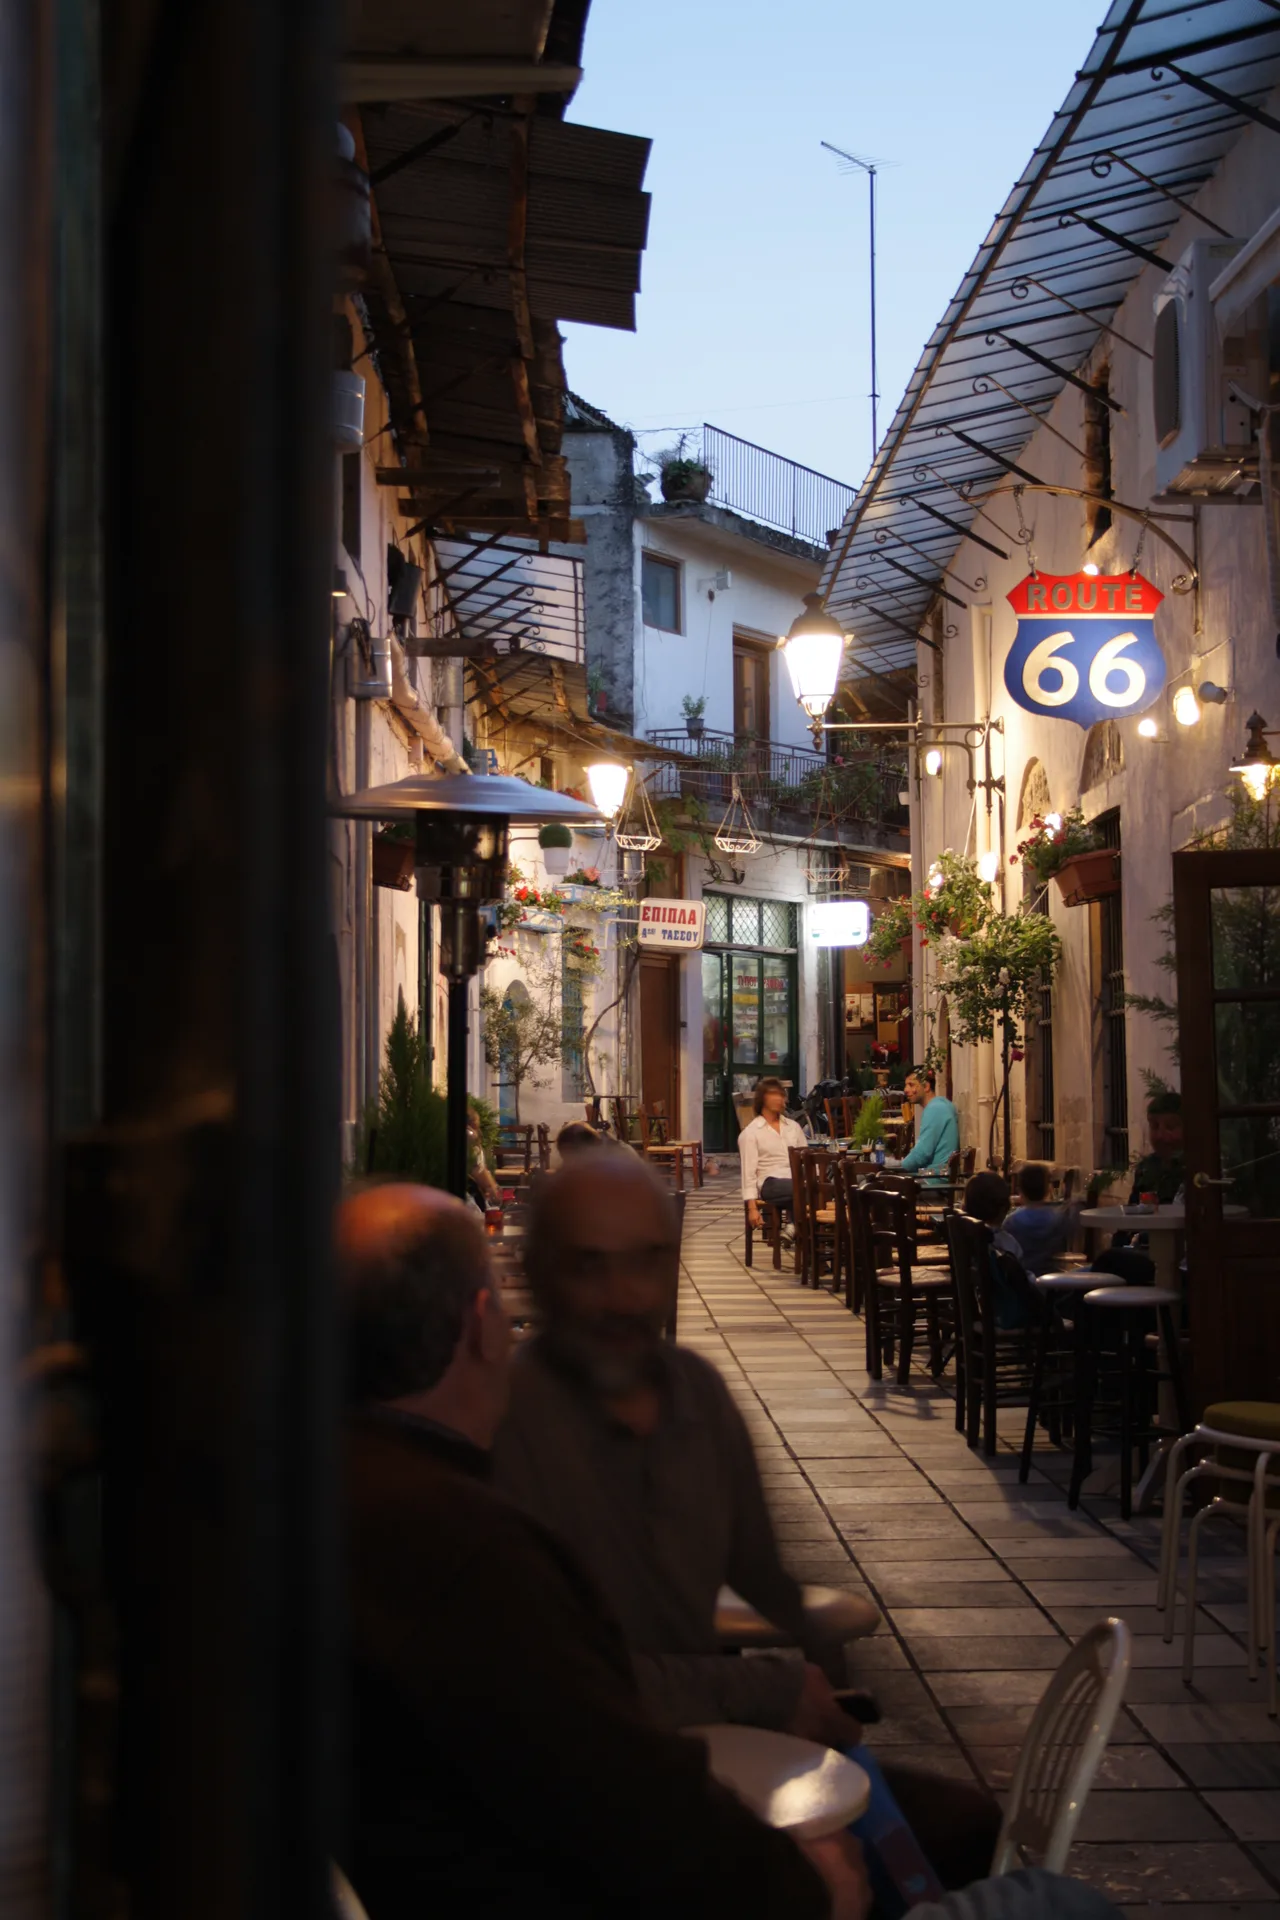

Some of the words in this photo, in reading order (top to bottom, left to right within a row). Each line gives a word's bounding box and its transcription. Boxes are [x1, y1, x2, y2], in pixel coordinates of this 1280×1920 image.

[1027, 583, 1143, 611] ROUTE
[1022, 631, 1146, 708] 66
[642, 906, 697, 924] ΕΠΙΠΛΑ
[662, 929, 699, 941] ΤΑΣΣΟΥ
